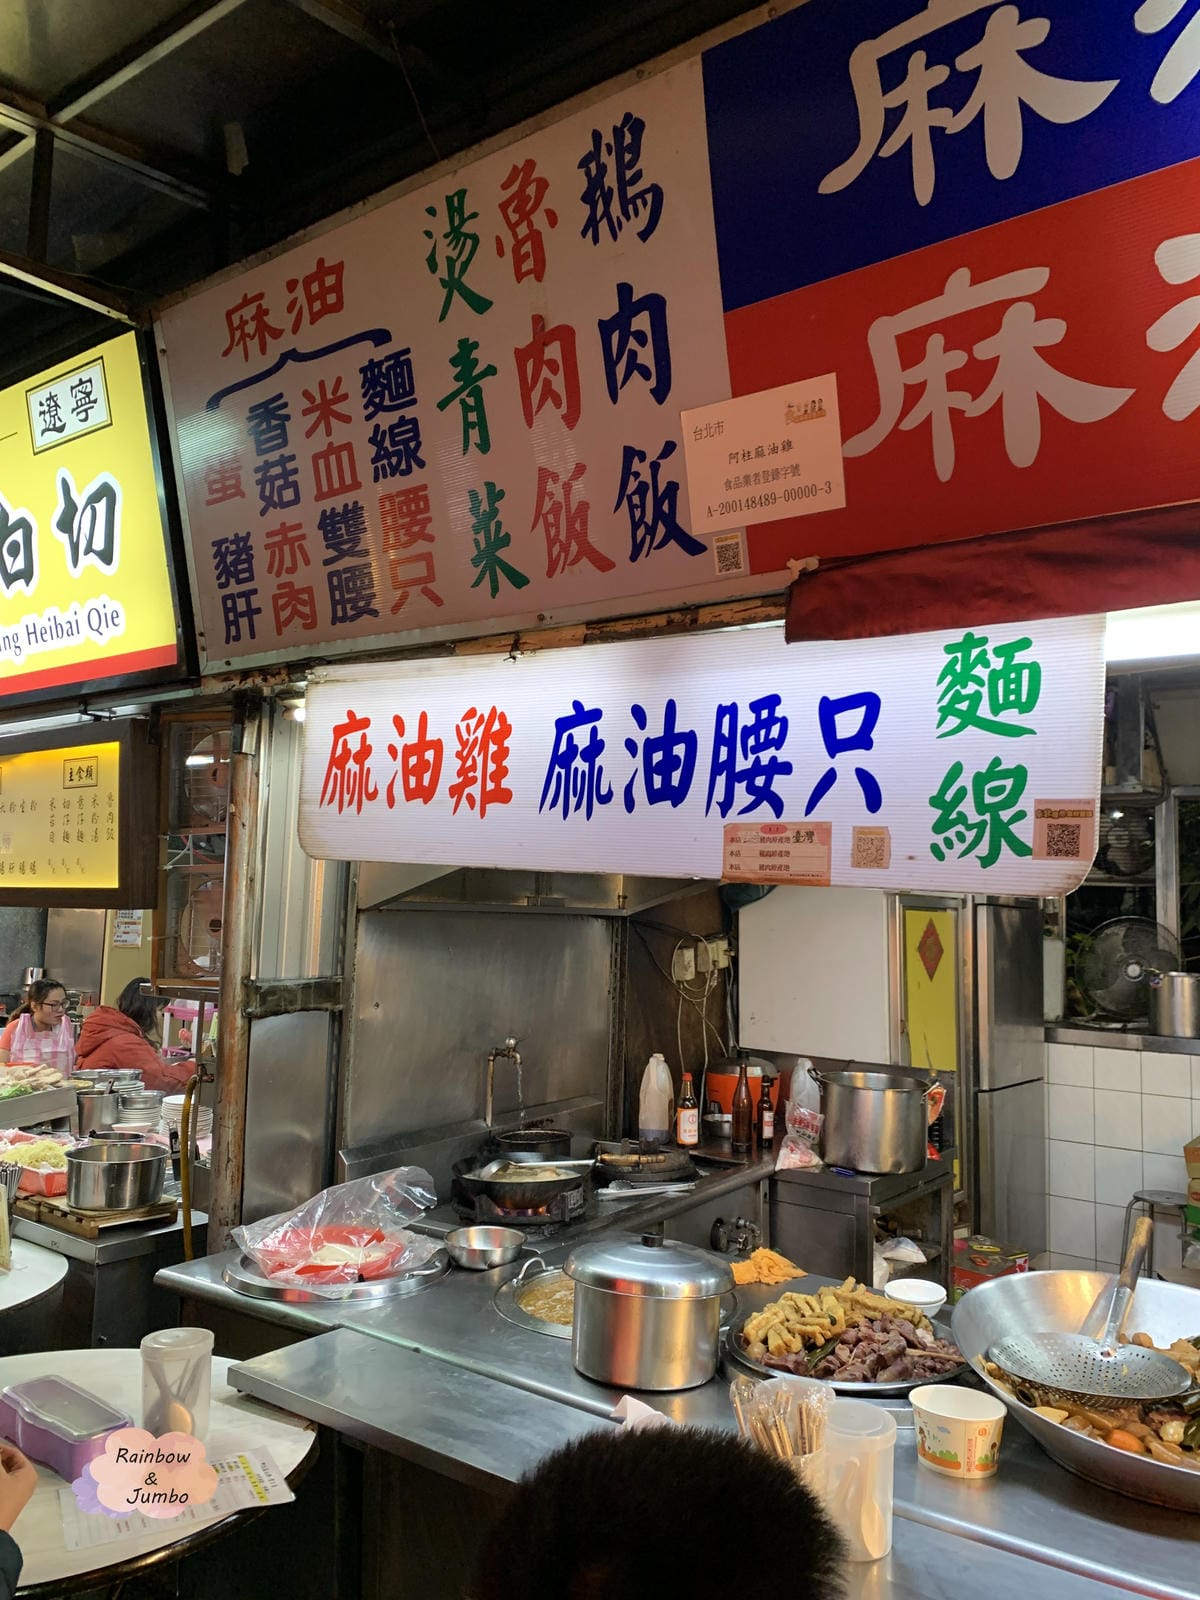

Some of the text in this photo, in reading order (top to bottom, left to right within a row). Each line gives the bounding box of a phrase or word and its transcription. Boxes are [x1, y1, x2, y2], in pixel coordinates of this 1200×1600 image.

[818, 0, 1200, 206] 麻
[222, 257, 345, 362] 麻油
[496, 159, 616, 578] 魯肉飯
[577, 112, 708, 562] 鵝肉飯
[39, 377, 98, 437] 遼寧
[424, 189, 530, 599] 燙青菜
[693, 421, 725, 442] 台北市
[707, 481, 833, 518] A-200148489-00000-3
[26, 610, 80, 646] Heibai
[87, 603, 121, 636] Qie
[319, 690, 882, 821] 麻油雞 麻油腰只
[928, 631, 1041, 869] 麵線
